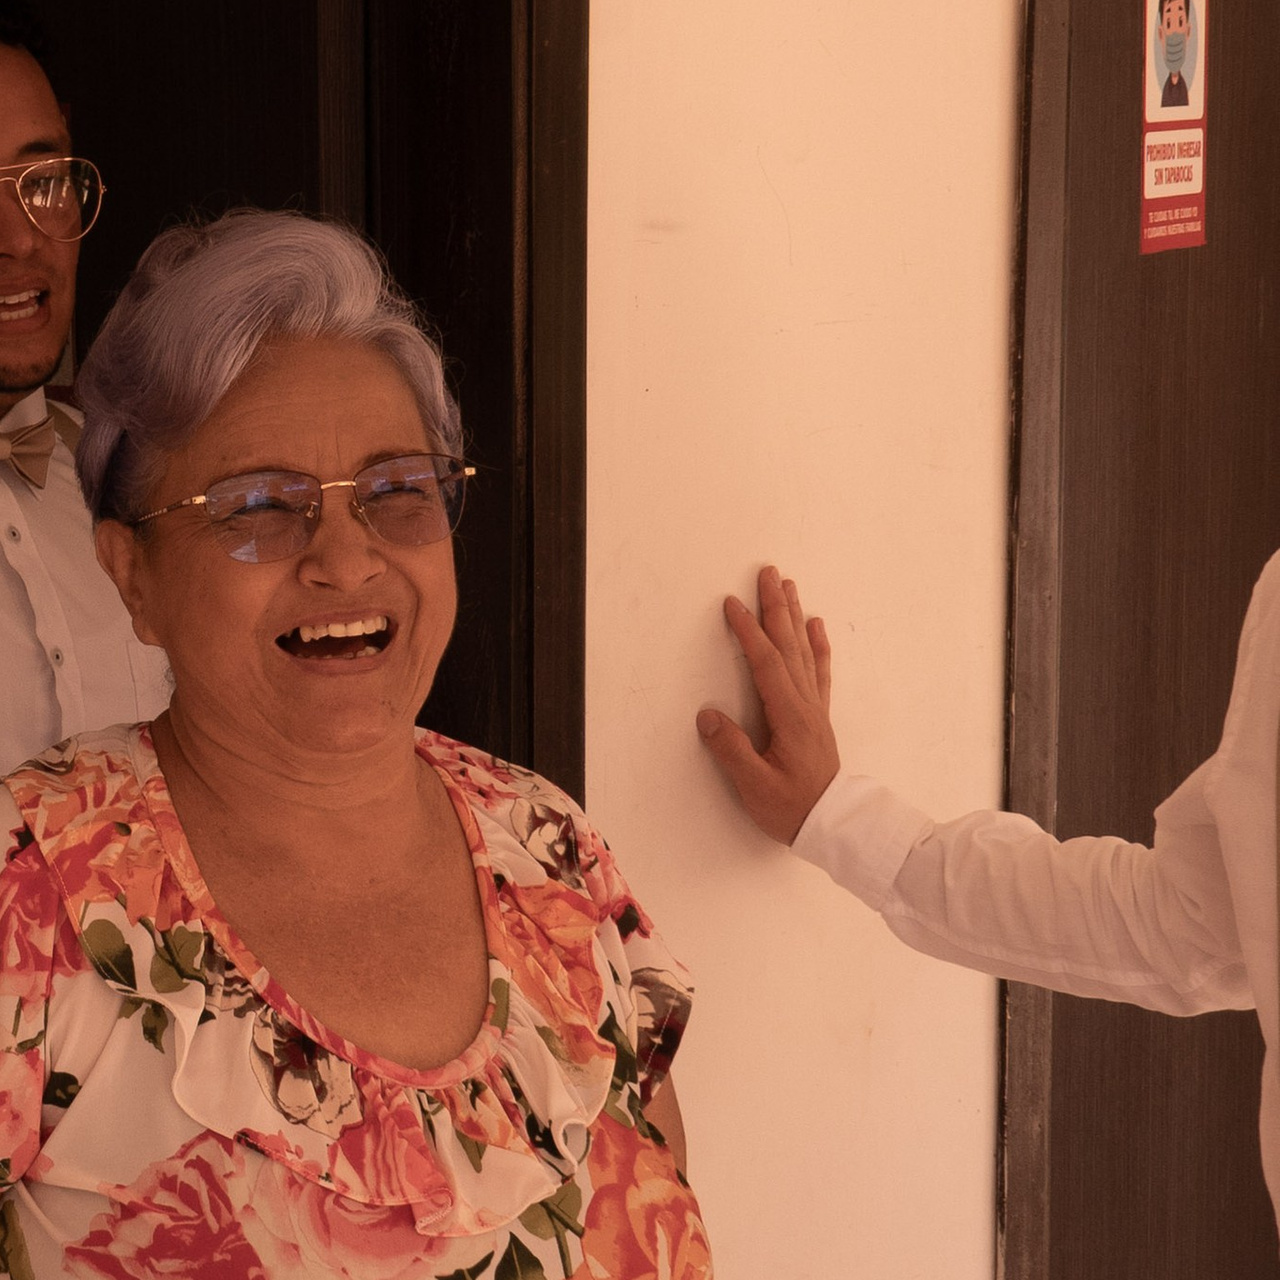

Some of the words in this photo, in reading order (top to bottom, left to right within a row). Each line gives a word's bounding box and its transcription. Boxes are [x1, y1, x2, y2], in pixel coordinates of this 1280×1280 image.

[1146, 143, 1176, 162] PROHIBIDO
[1177, 140, 1202, 159] INGRESAR
[1154, 168, 1164, 186] SIN
[1165, 164, 1193, 184] TAPABOCAS
